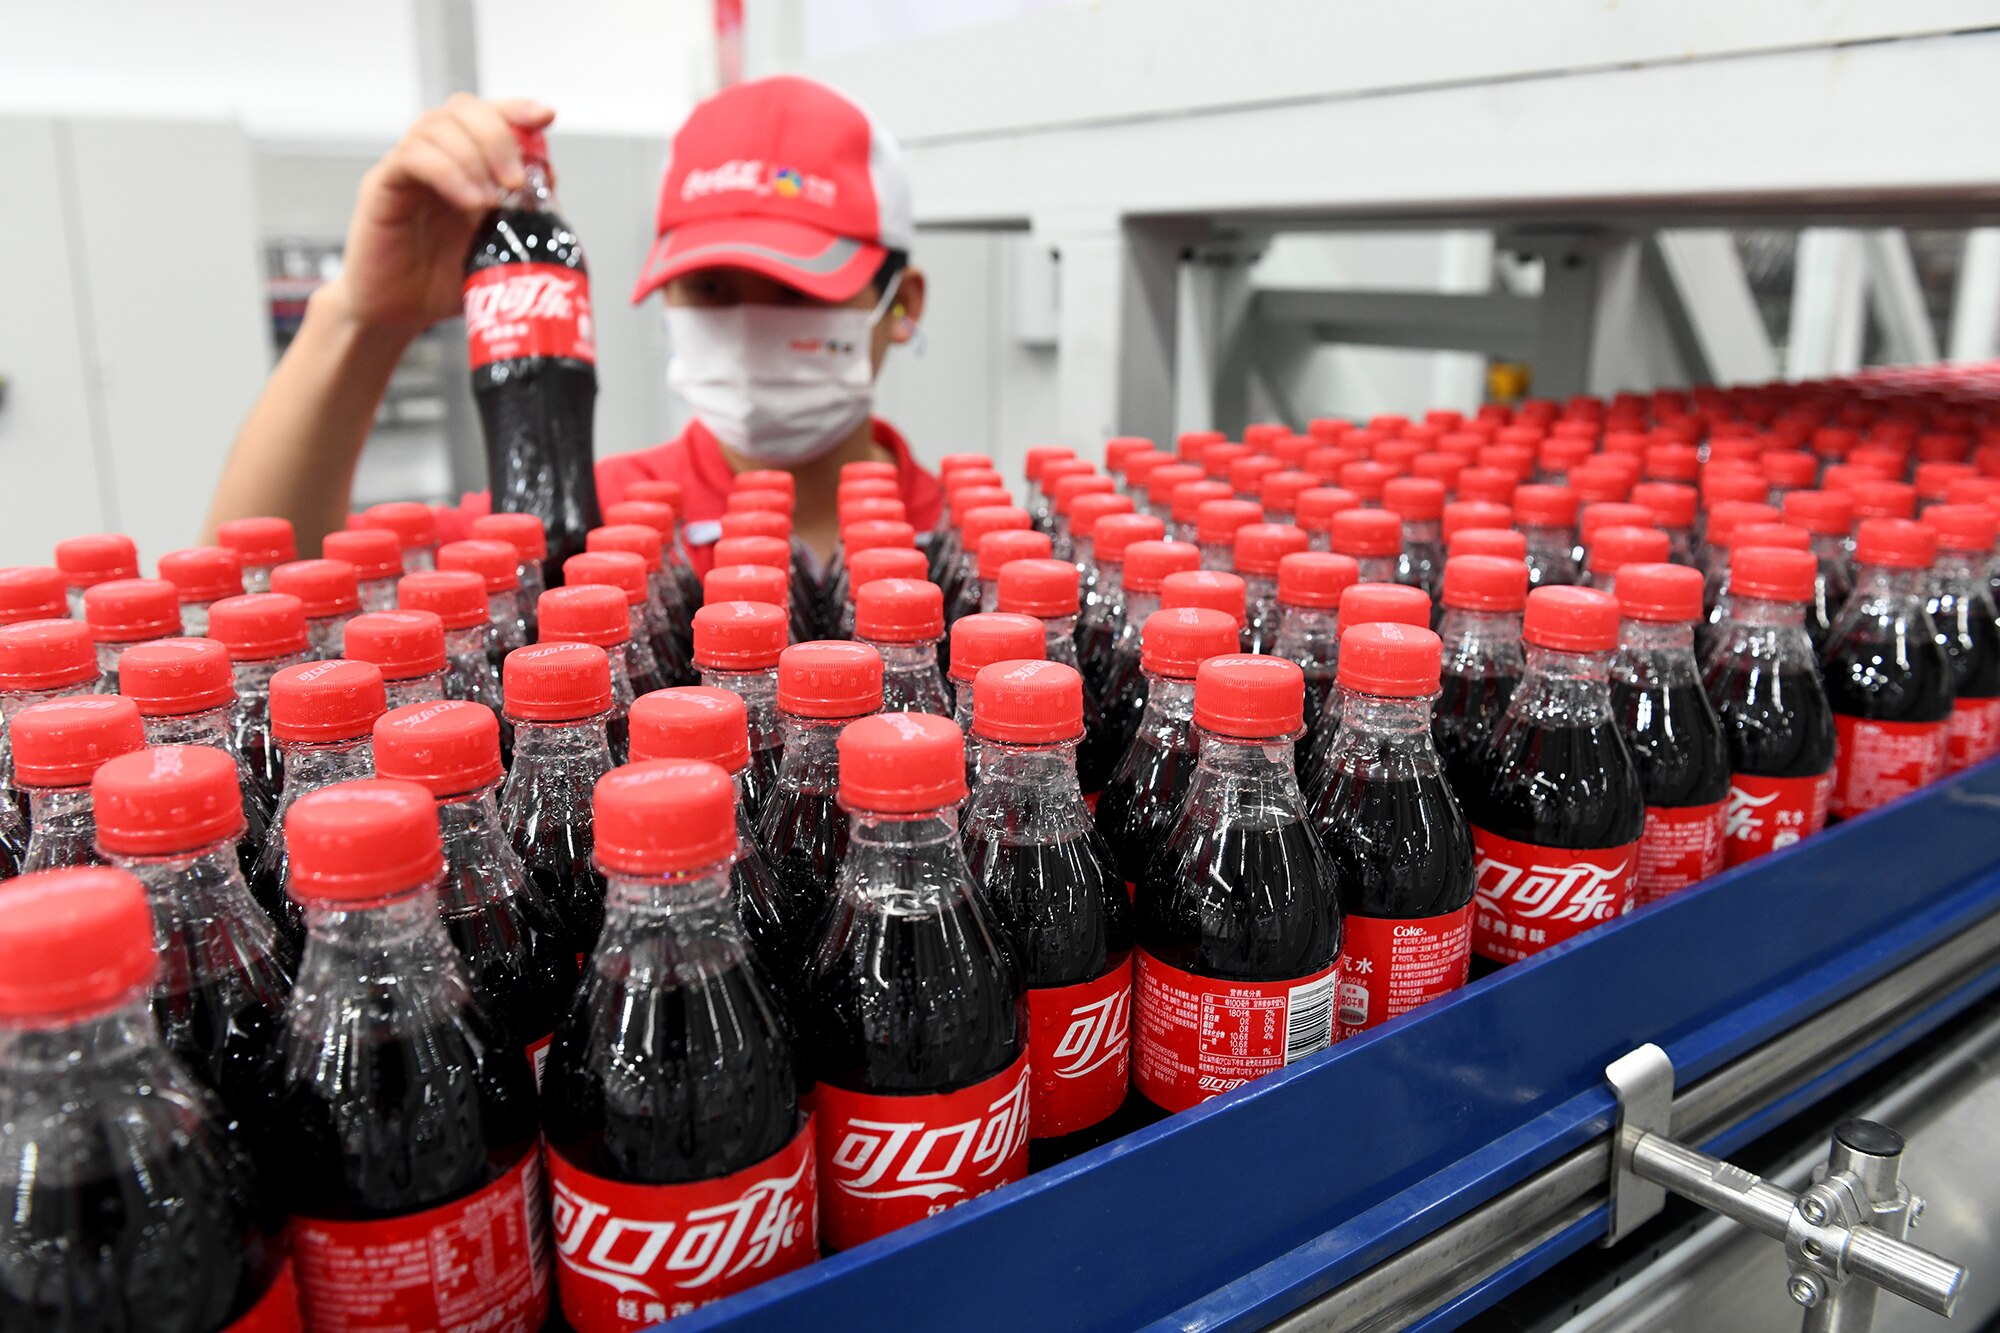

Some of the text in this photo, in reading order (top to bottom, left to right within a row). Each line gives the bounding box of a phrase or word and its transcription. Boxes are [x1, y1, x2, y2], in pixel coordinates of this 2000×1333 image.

[1476, 848, 1628, 922] 口可乐
[1393, 926, 1424, 937] Coke
[1198, 1075, 1250, 1092] 可口可
[552, 1147, 810, 1289] 可口可乐
